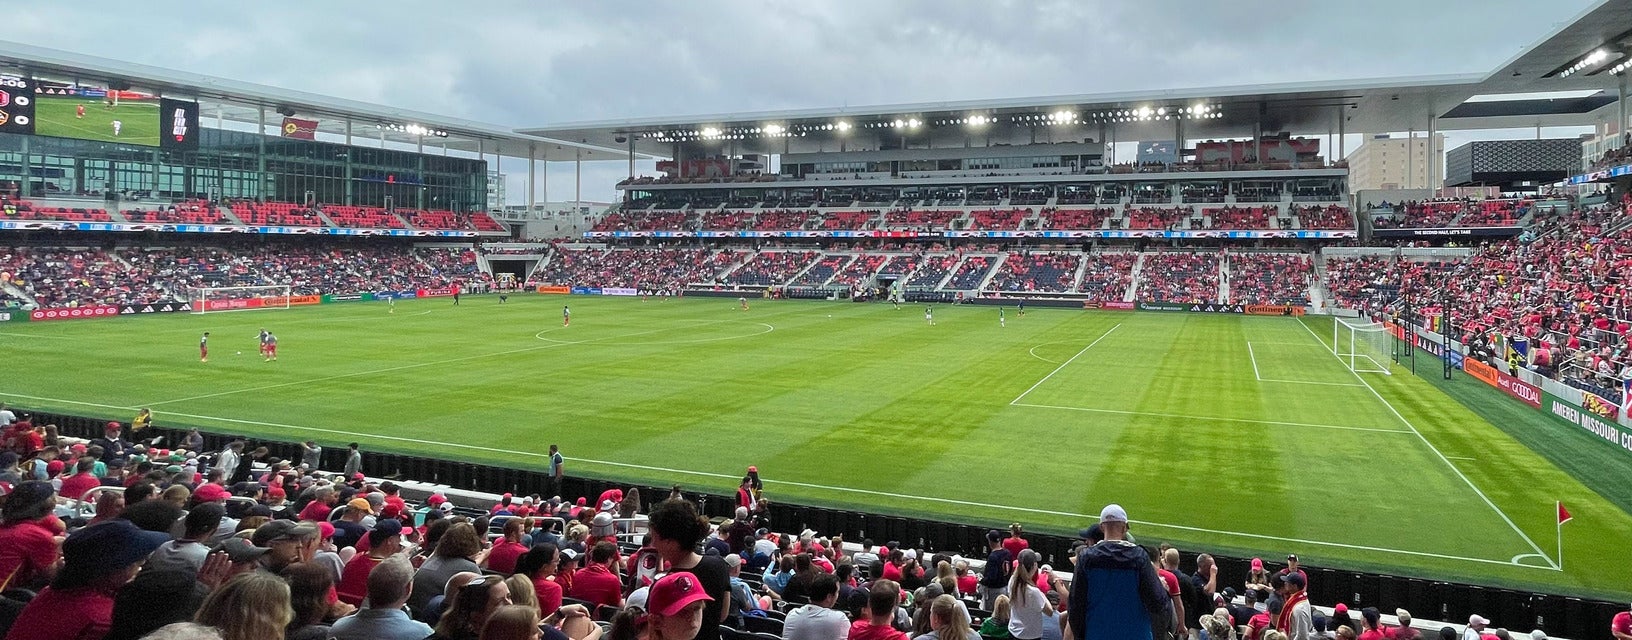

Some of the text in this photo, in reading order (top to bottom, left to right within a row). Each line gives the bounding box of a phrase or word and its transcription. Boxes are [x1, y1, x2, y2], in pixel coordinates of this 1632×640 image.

[15, 96, 29, 106] 0
[15, 115, 29, 125] 0
[1497, 375, 1510, 388] Audi
[1552, 400, 1580, 425] AMEREN
[1581, 413, 1619, 445] MISSOURI
